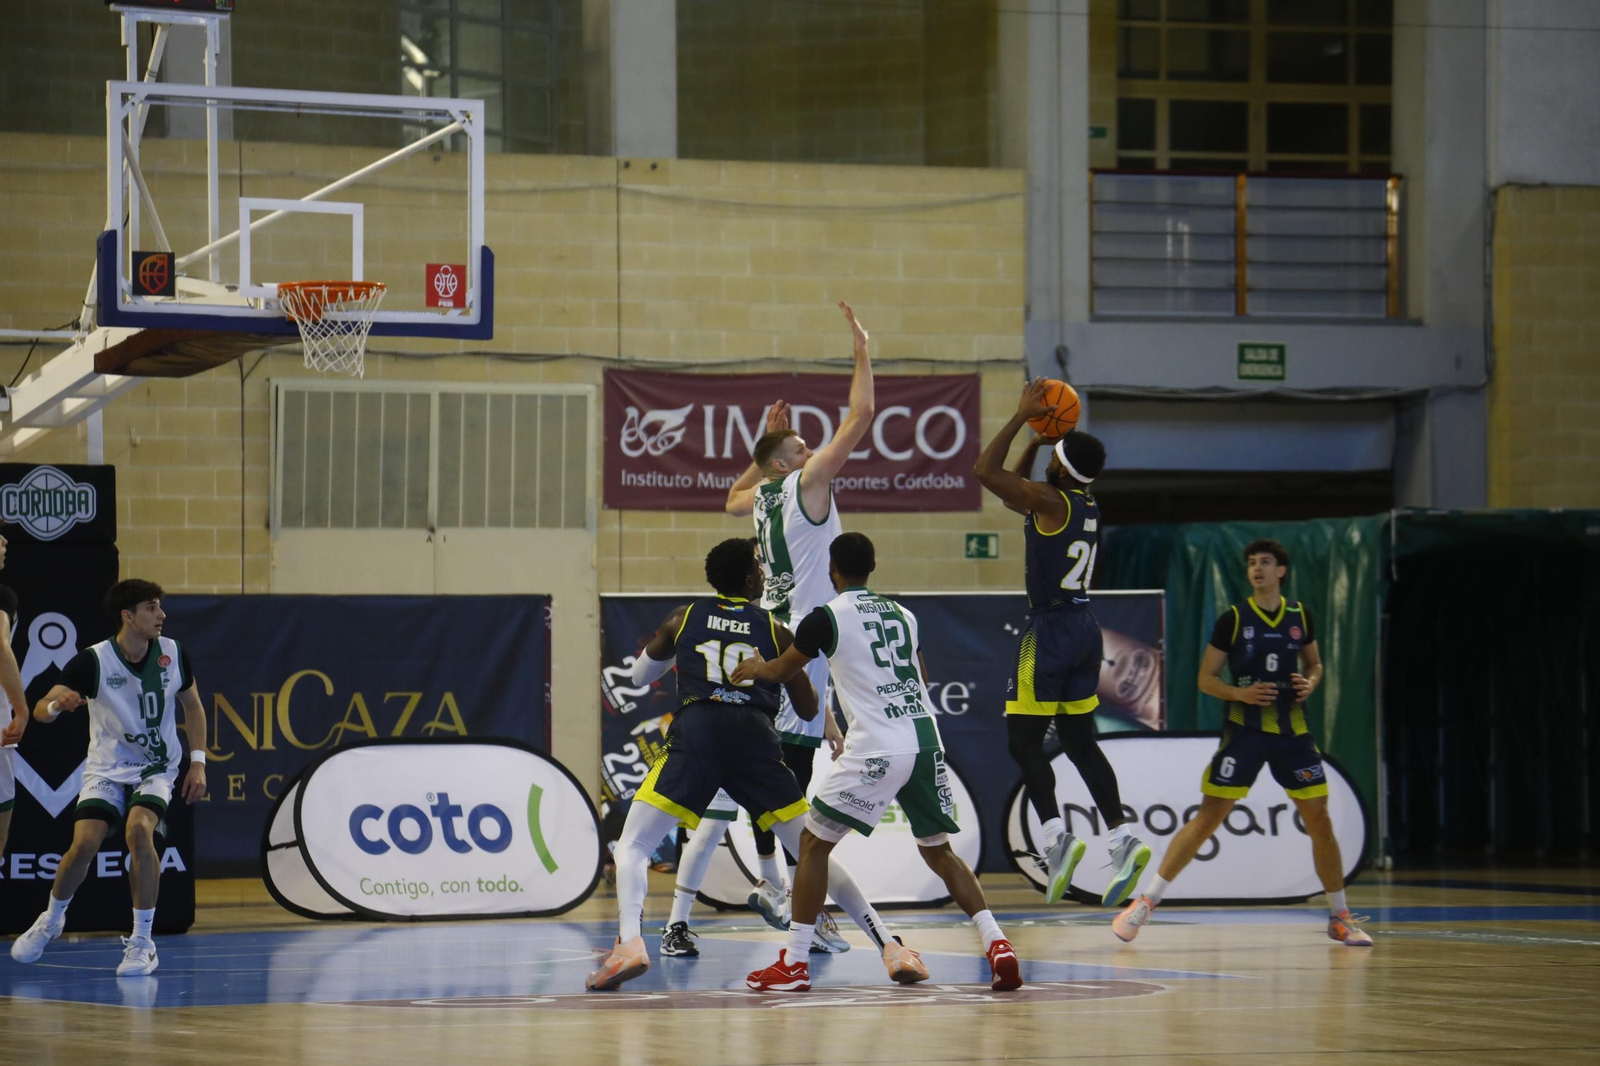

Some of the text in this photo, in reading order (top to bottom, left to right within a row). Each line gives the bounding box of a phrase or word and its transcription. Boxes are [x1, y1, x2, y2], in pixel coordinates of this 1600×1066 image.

[620, 470, 692, 489] Instituto
[830, 477, 889, 493] eportes
[893, 474, 965, 490] Córdoba
[707, 614, 751, 635] IKPEZE
[863, 619, 909, 668] 22
[1265, 653, 1279, 672] 6
[138, 692, 158, 719] 10
[1219, 756, 1236, 778] 6
[840, 790, 876, 812] efficold
[349, 792, 513, 855] coto
[360, 874, 524, 900] Contigo, con todo.
